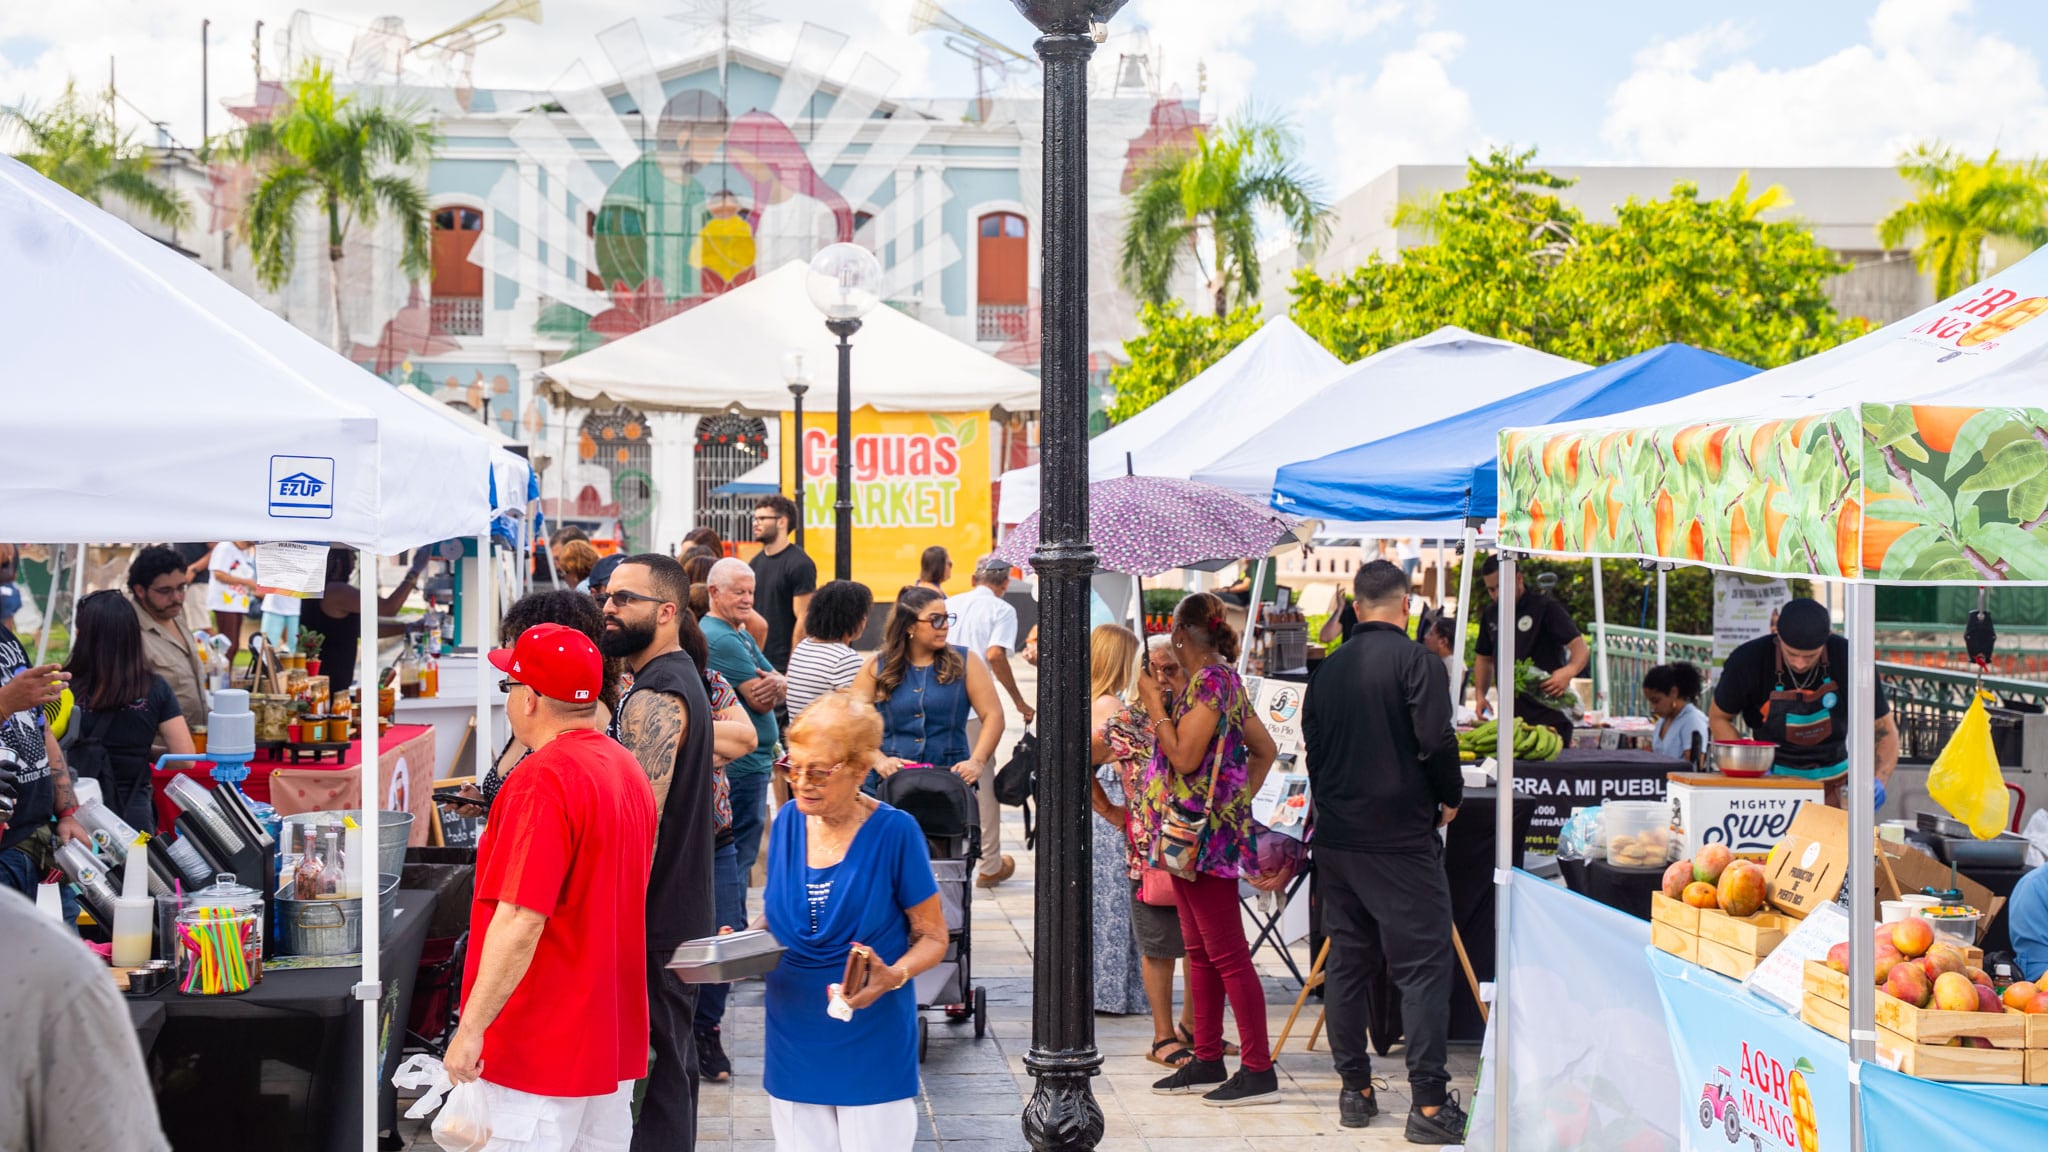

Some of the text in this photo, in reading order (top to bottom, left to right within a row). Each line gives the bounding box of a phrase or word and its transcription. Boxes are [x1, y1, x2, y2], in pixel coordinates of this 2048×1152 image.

[805, 482, 958, 525] MARKET
[278, 542, 308, 551] WARNING
[1556, 779, 1571, 795] A
[1575, 780, 1596, 796] MI
[1730, 800, 1786, 809] MIGHTY
[1703, 799, 1812, 849] Swel
